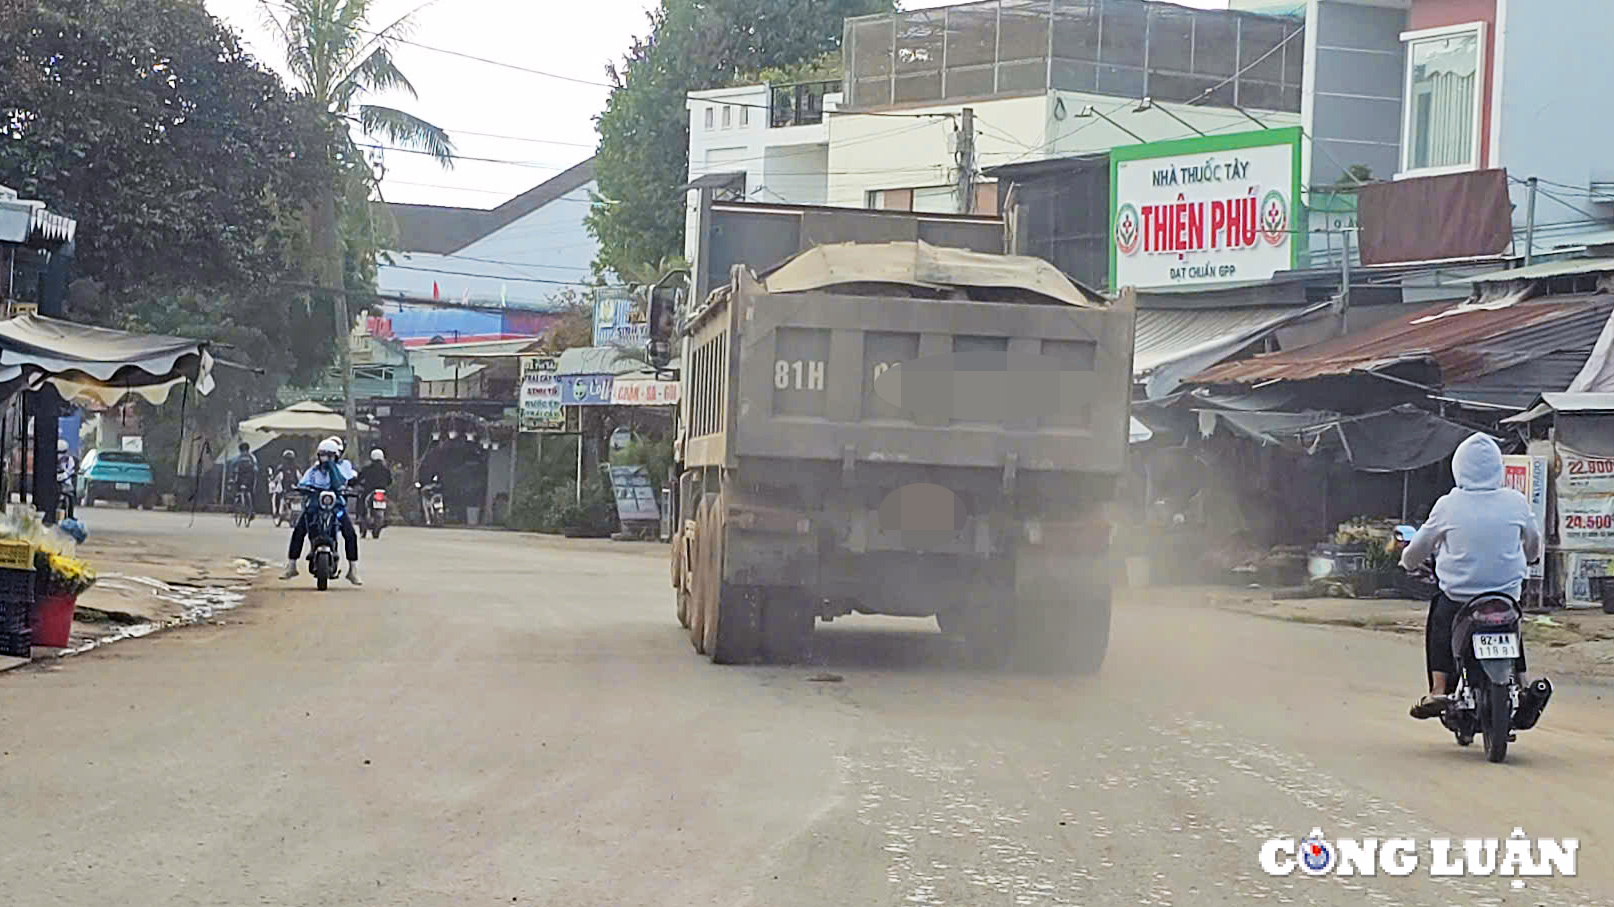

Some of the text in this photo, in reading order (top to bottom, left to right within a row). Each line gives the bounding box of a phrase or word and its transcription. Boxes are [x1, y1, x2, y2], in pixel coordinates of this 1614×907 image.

[1152, 157, 1249, 186] NHÀ THUỐC TÂY
[1141, 186, 1258, 260] THIỆN PHÚ
[1188, 260, 1216, 278] CHUẨN
[1218, 265, 1236, 277] GPP
[774, 360, 825, 391] 81H
